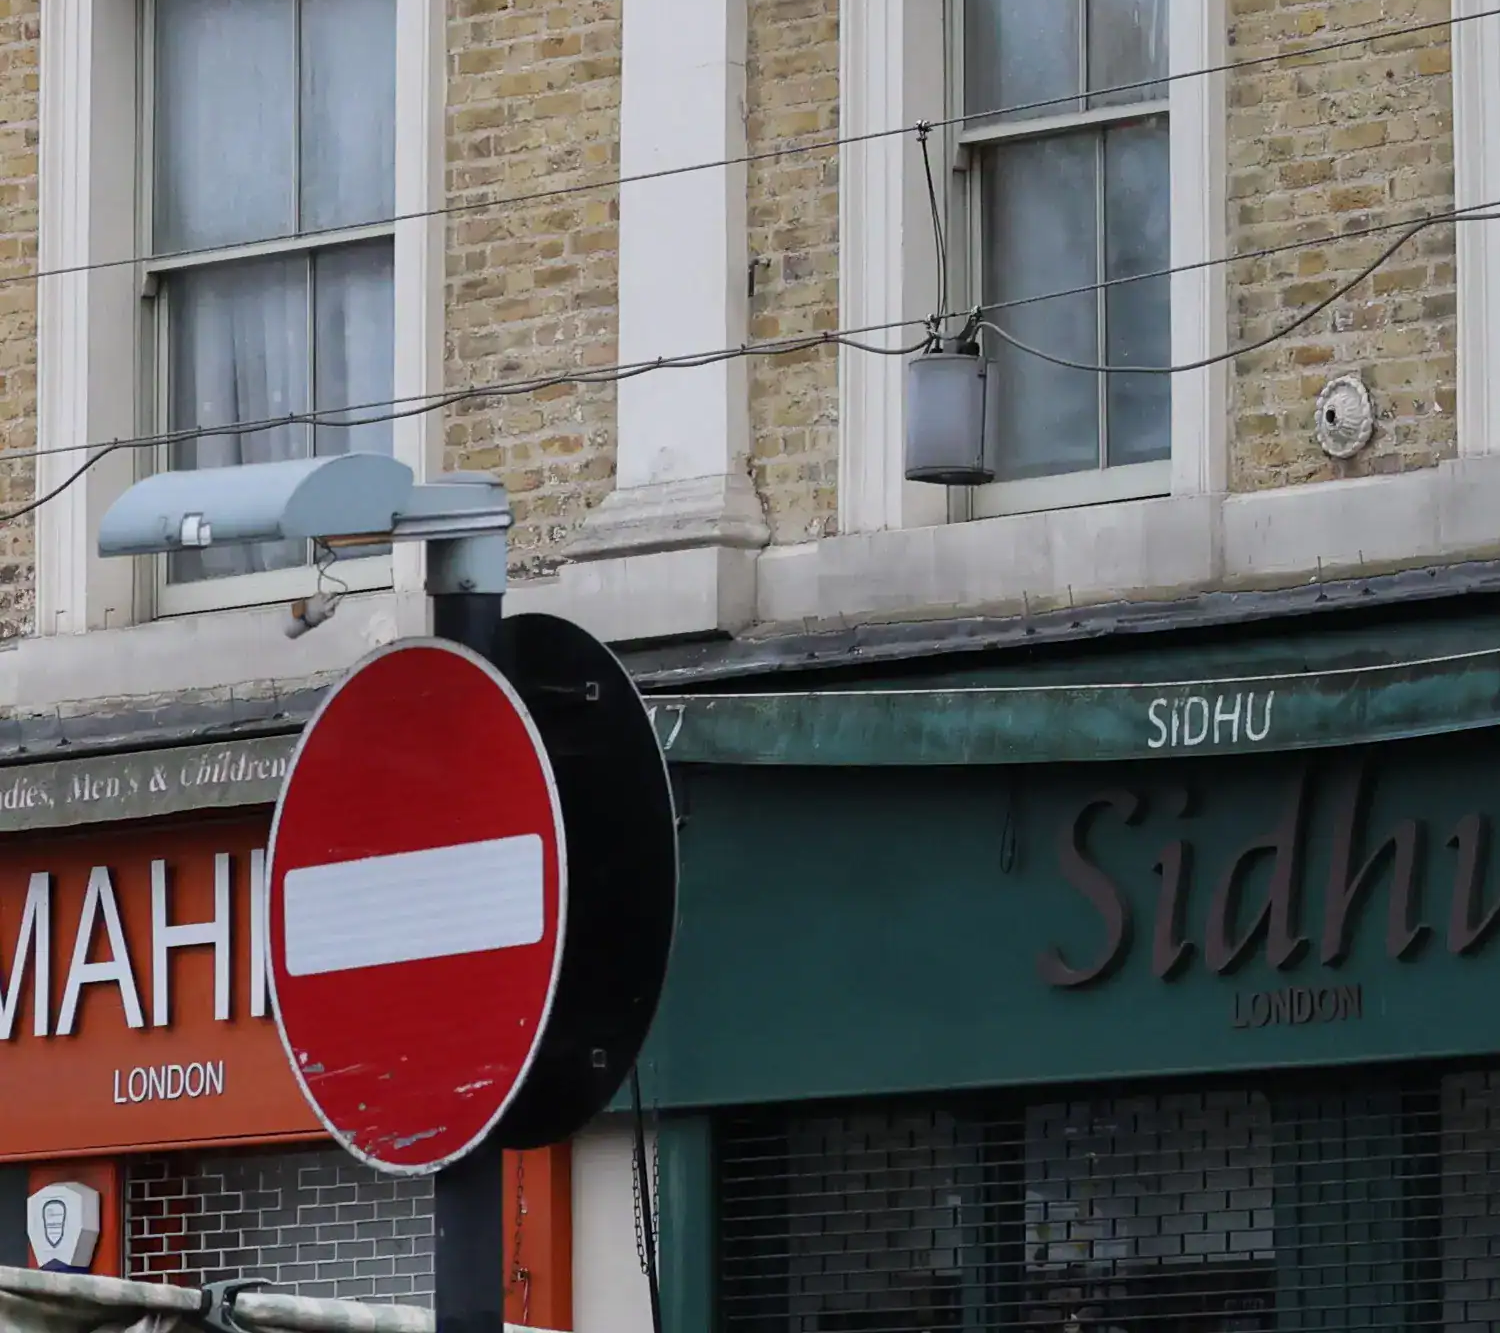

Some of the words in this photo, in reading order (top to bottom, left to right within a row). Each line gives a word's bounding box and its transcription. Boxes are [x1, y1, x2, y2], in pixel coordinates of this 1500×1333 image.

[1147, 691, 1274, 749] SIDHU
[149, 763, 167, 792] &
[1230, 984, 1362, 1029] LONDON
[113, 1060, 224, 1103] LONDON
